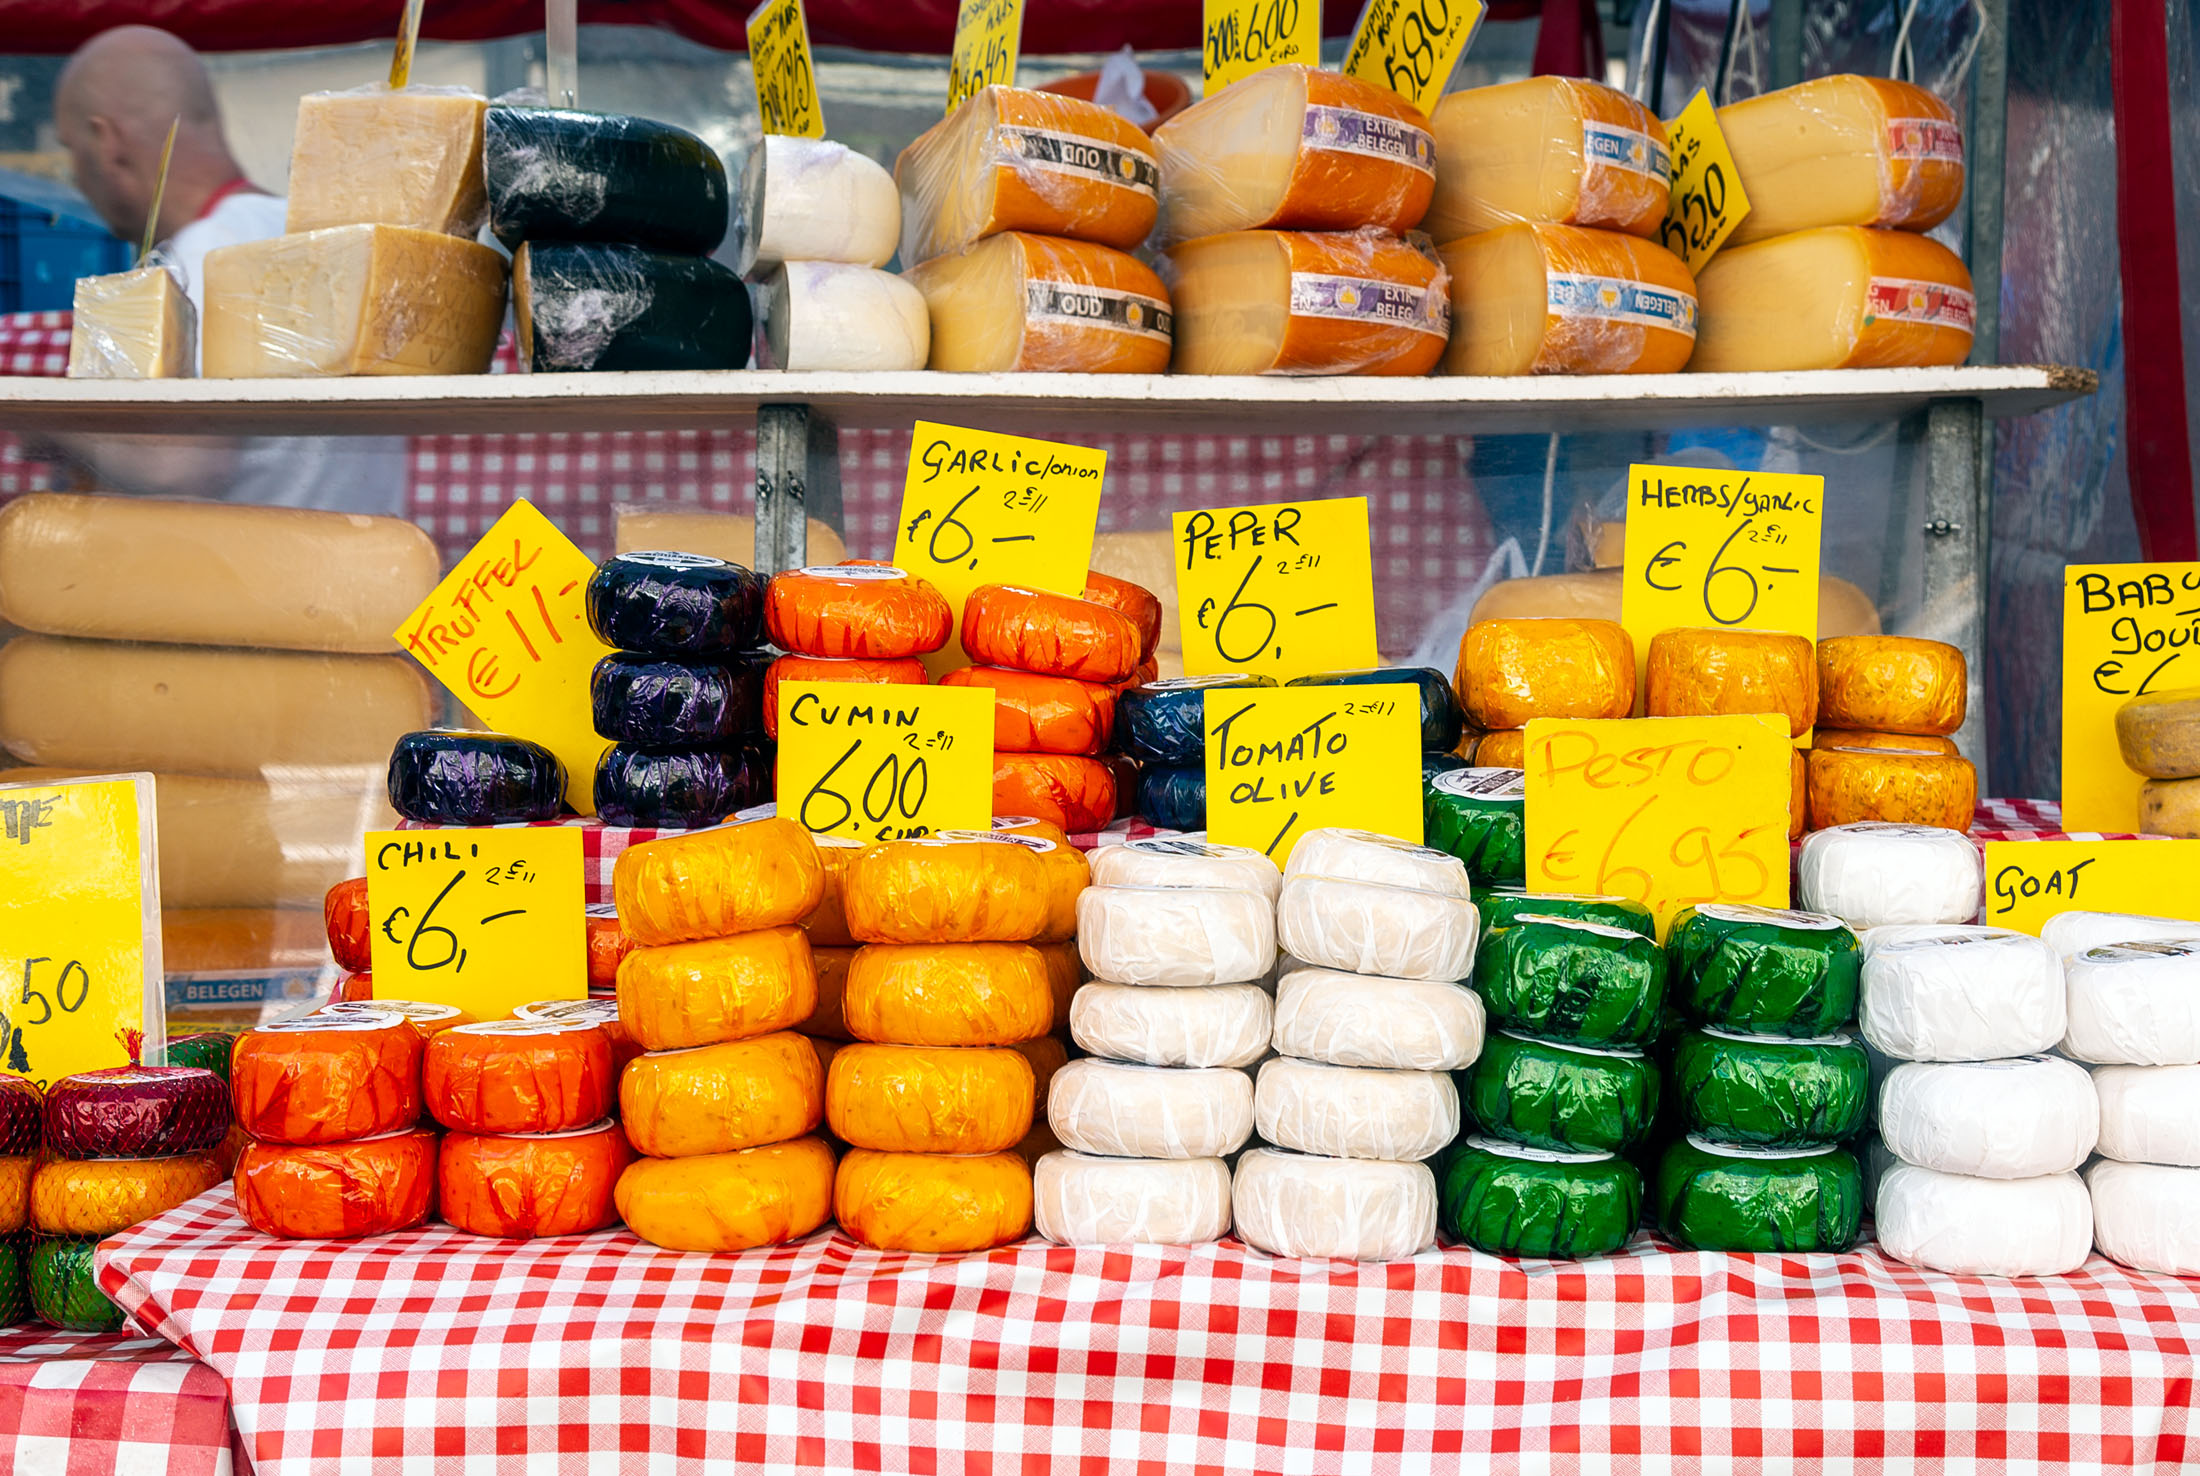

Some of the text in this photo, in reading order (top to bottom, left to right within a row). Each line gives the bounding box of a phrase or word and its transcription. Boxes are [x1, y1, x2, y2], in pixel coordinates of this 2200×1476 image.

[1365, 116, 1402, 139] EXTRA
[1062, 144, 1101, 168] OUD
[1357, 133, 1408, 156] BELEGEN
[1061, 294, 1103, 318] OUD
[408, 538, 542, 666] TRUFFEL
[790, 693, 919, 727] CUMIN
[1211, 703, 1347, 770] TOMATO
[800, 738, 927, 833] 6,00
[1230, 771, 1335, 804] OLIVE
[378, 841, 479, 870] CHILI
[1995, 858, 2096, 914] GOAT
[186, 983, 264, 999] BELEGEN
